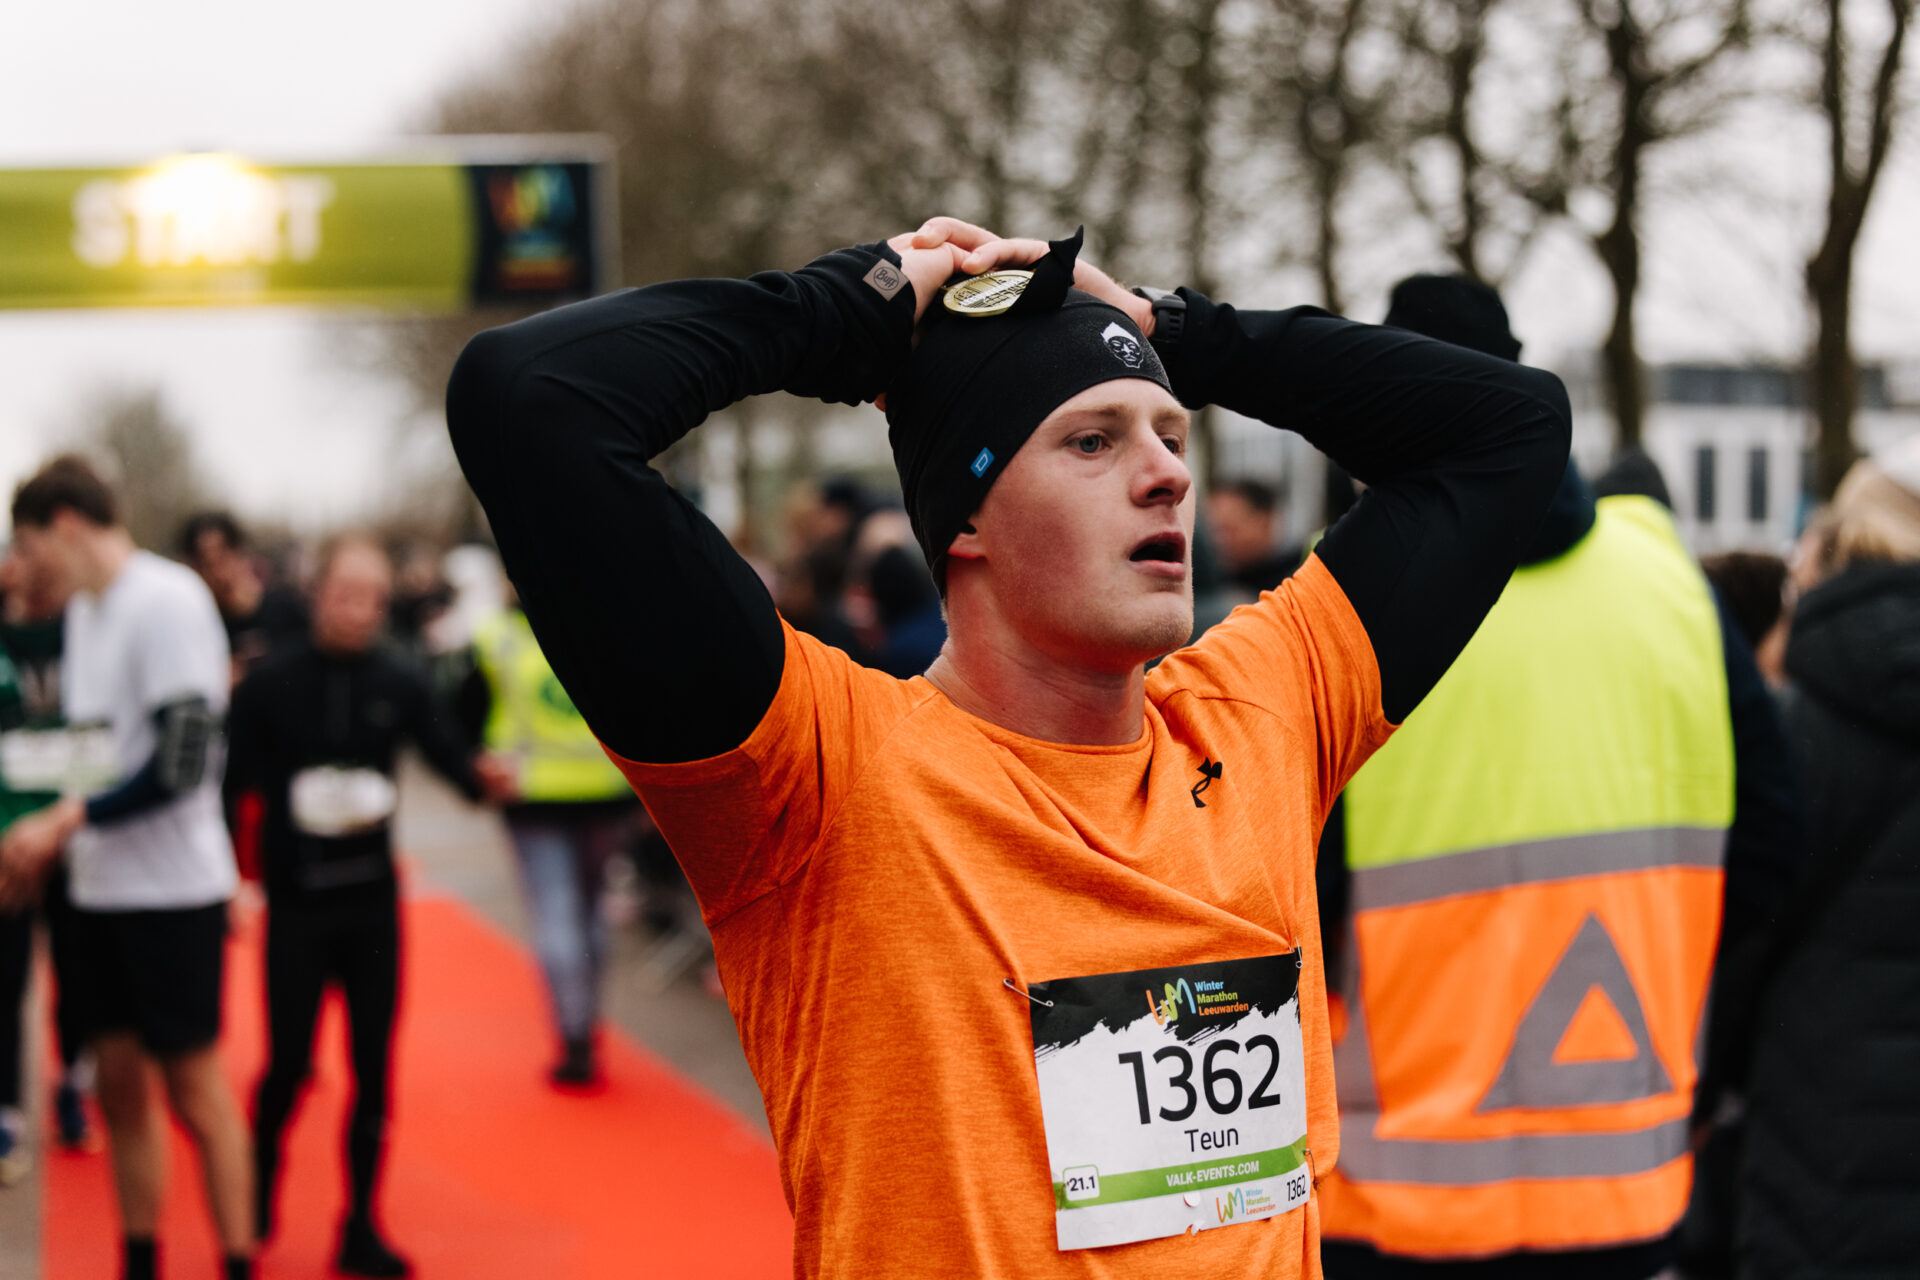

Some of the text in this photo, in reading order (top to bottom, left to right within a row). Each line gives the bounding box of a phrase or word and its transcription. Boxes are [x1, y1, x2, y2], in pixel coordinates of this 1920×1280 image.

[876, 269, 897, 288] Buff
[1194, 981, 1224, 992] Winter
[1197, 991, 1238, 1004] Marathon
[1198, 1001, 1249, 1016] Leeuwarden
[1118, 1034, 1280, 1124] 1362
[1184, 1128, 1239, 1152] Teun
[1166, 1160, 1260, 1187] VALK-EVENTS.COM
[1068, 1176, 1096, 1192] 21.1
[1286, 1174, 1306, 1202] 1362
